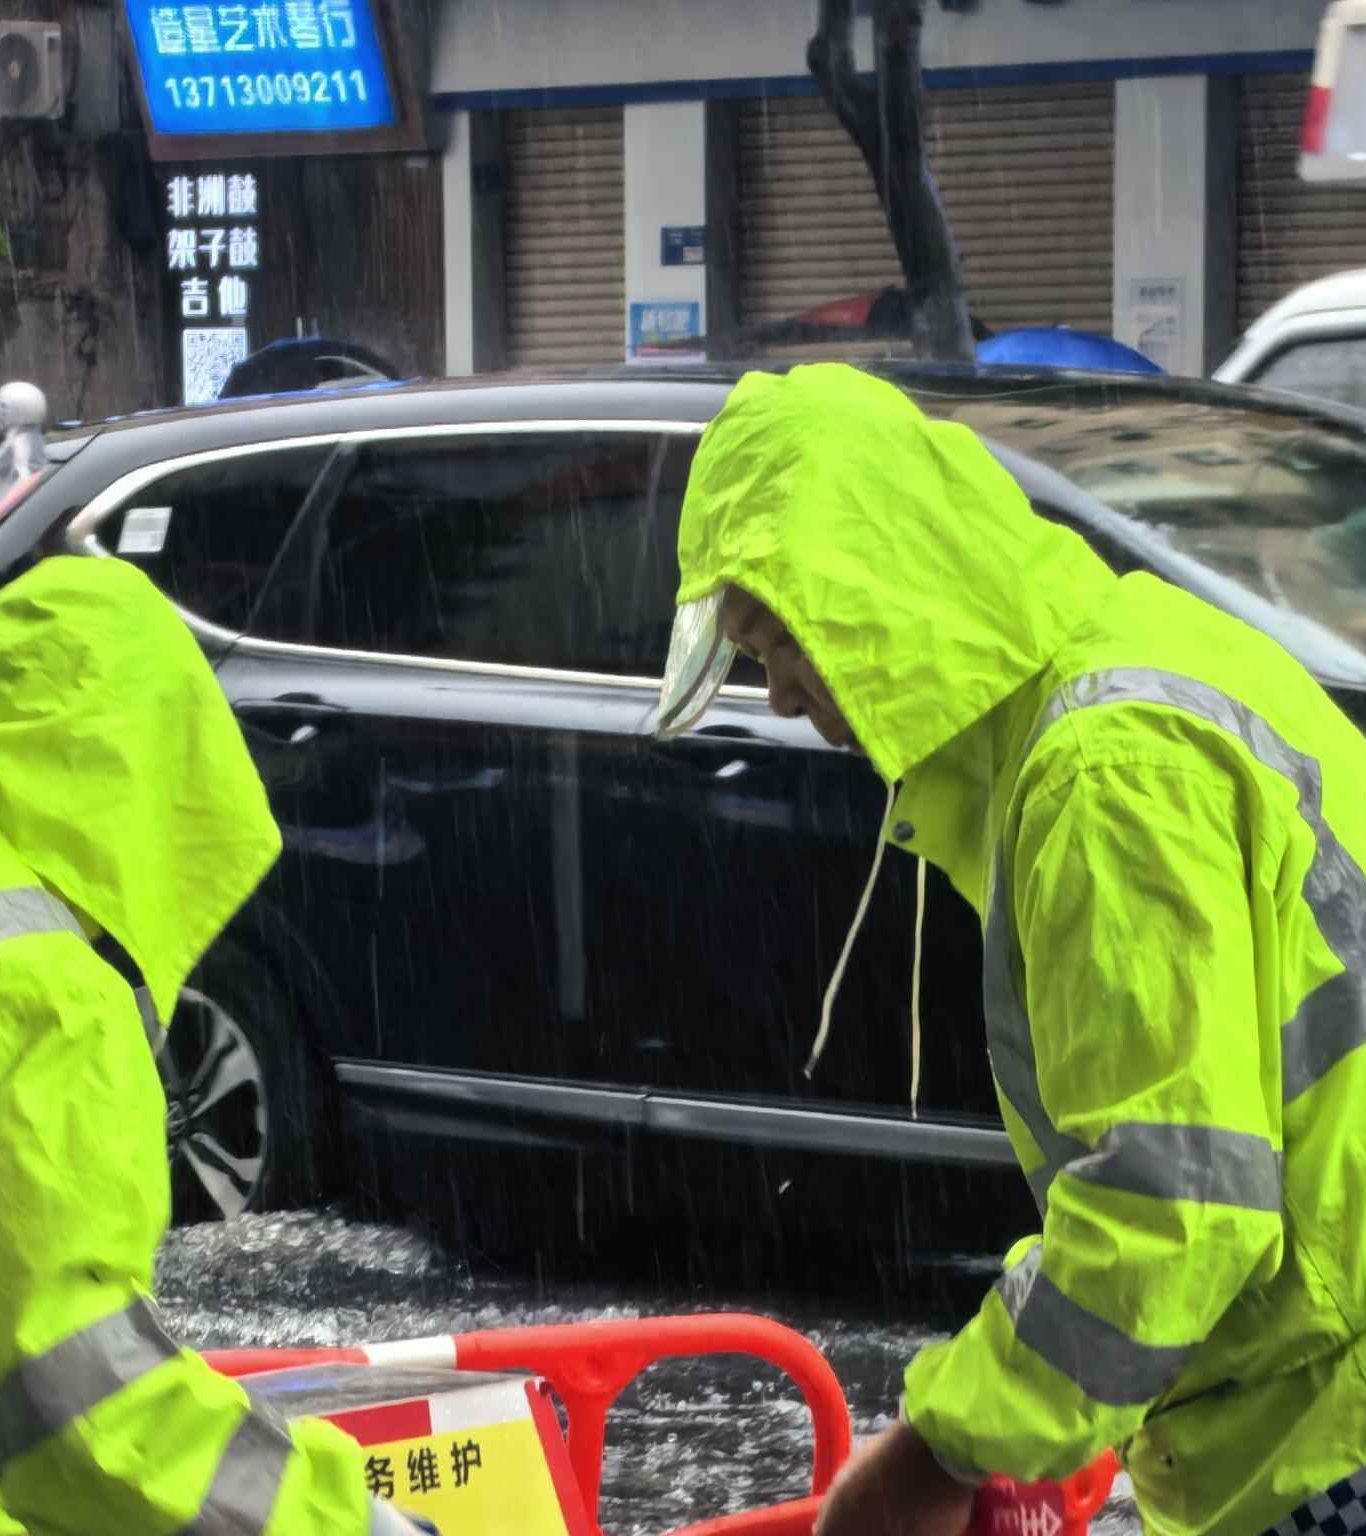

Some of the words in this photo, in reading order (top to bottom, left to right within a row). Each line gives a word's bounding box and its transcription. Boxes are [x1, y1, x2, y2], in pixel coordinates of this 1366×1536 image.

[165, 69, 367, 108] 13713009211
[167, 174, 257, 217] 非洲鼓
[168, 226, 258, 269] 架子鼓
